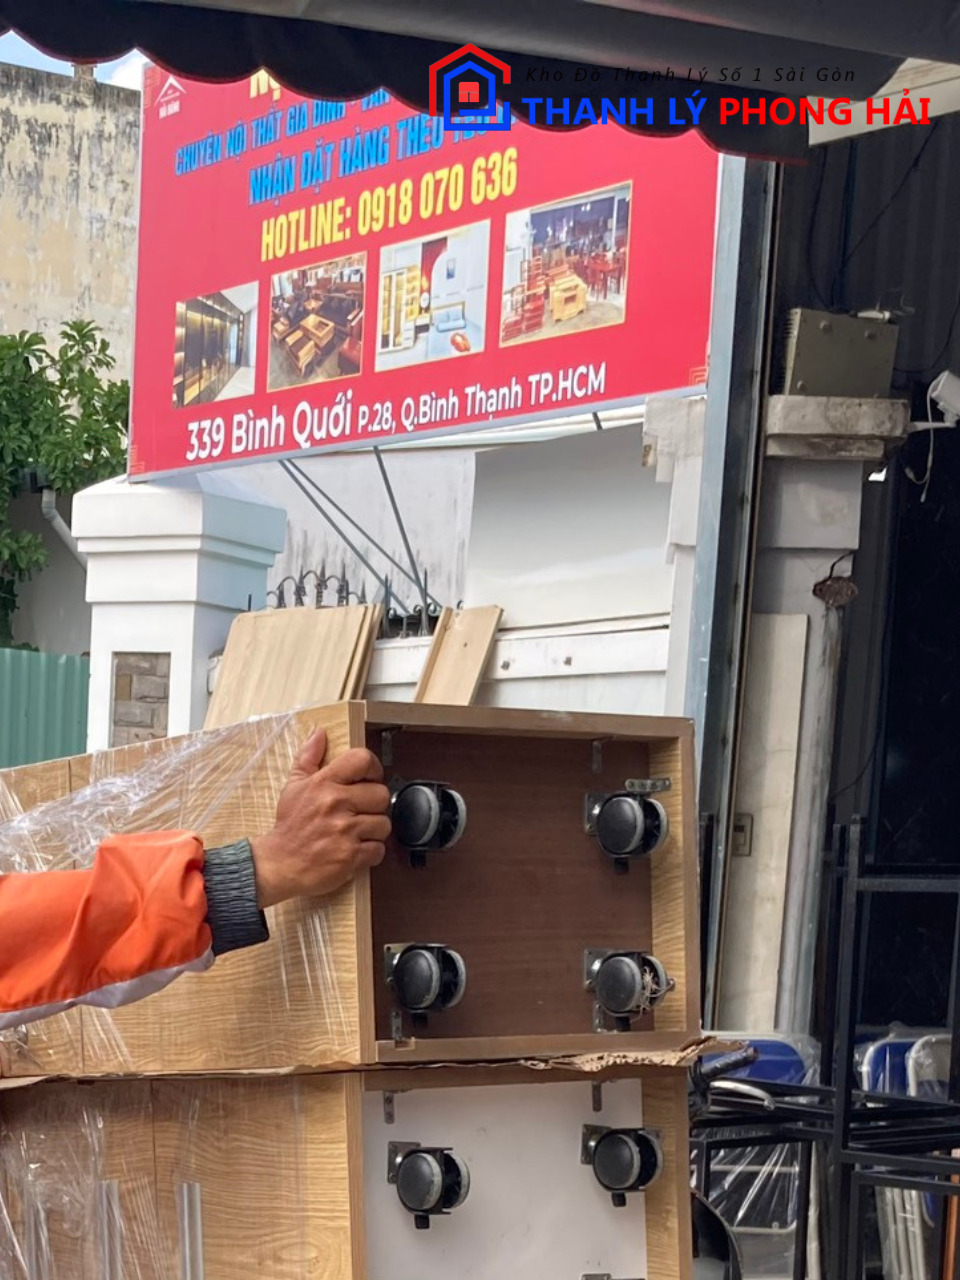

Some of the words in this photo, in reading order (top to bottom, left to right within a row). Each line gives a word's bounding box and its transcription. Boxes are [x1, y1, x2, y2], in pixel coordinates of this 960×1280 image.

[286, 101, 309, 137] GIA
[249, 153, 297, 206] NHẬN
[300, 138, 336, 194] ĐẶT
[338, 126, 390, 178] HÀNG
[261, 197, 352, 262] HOTLINE:
[358, 178, 413, 236] 0918
[420, 163, 464, 220] 070
[471, 147, 518, 206] 636
[186, 417, 225, 461] 339
[232, 404, 285, 454] Bình
[293, 388, 353, 449] Quới
[358, 401, 396, 434] P.28,
[401, 389, 459, 432] Q.Bình
[465, 376, 522, 421] Thạnh
[528, 361, 606, 405] TP.HCM
